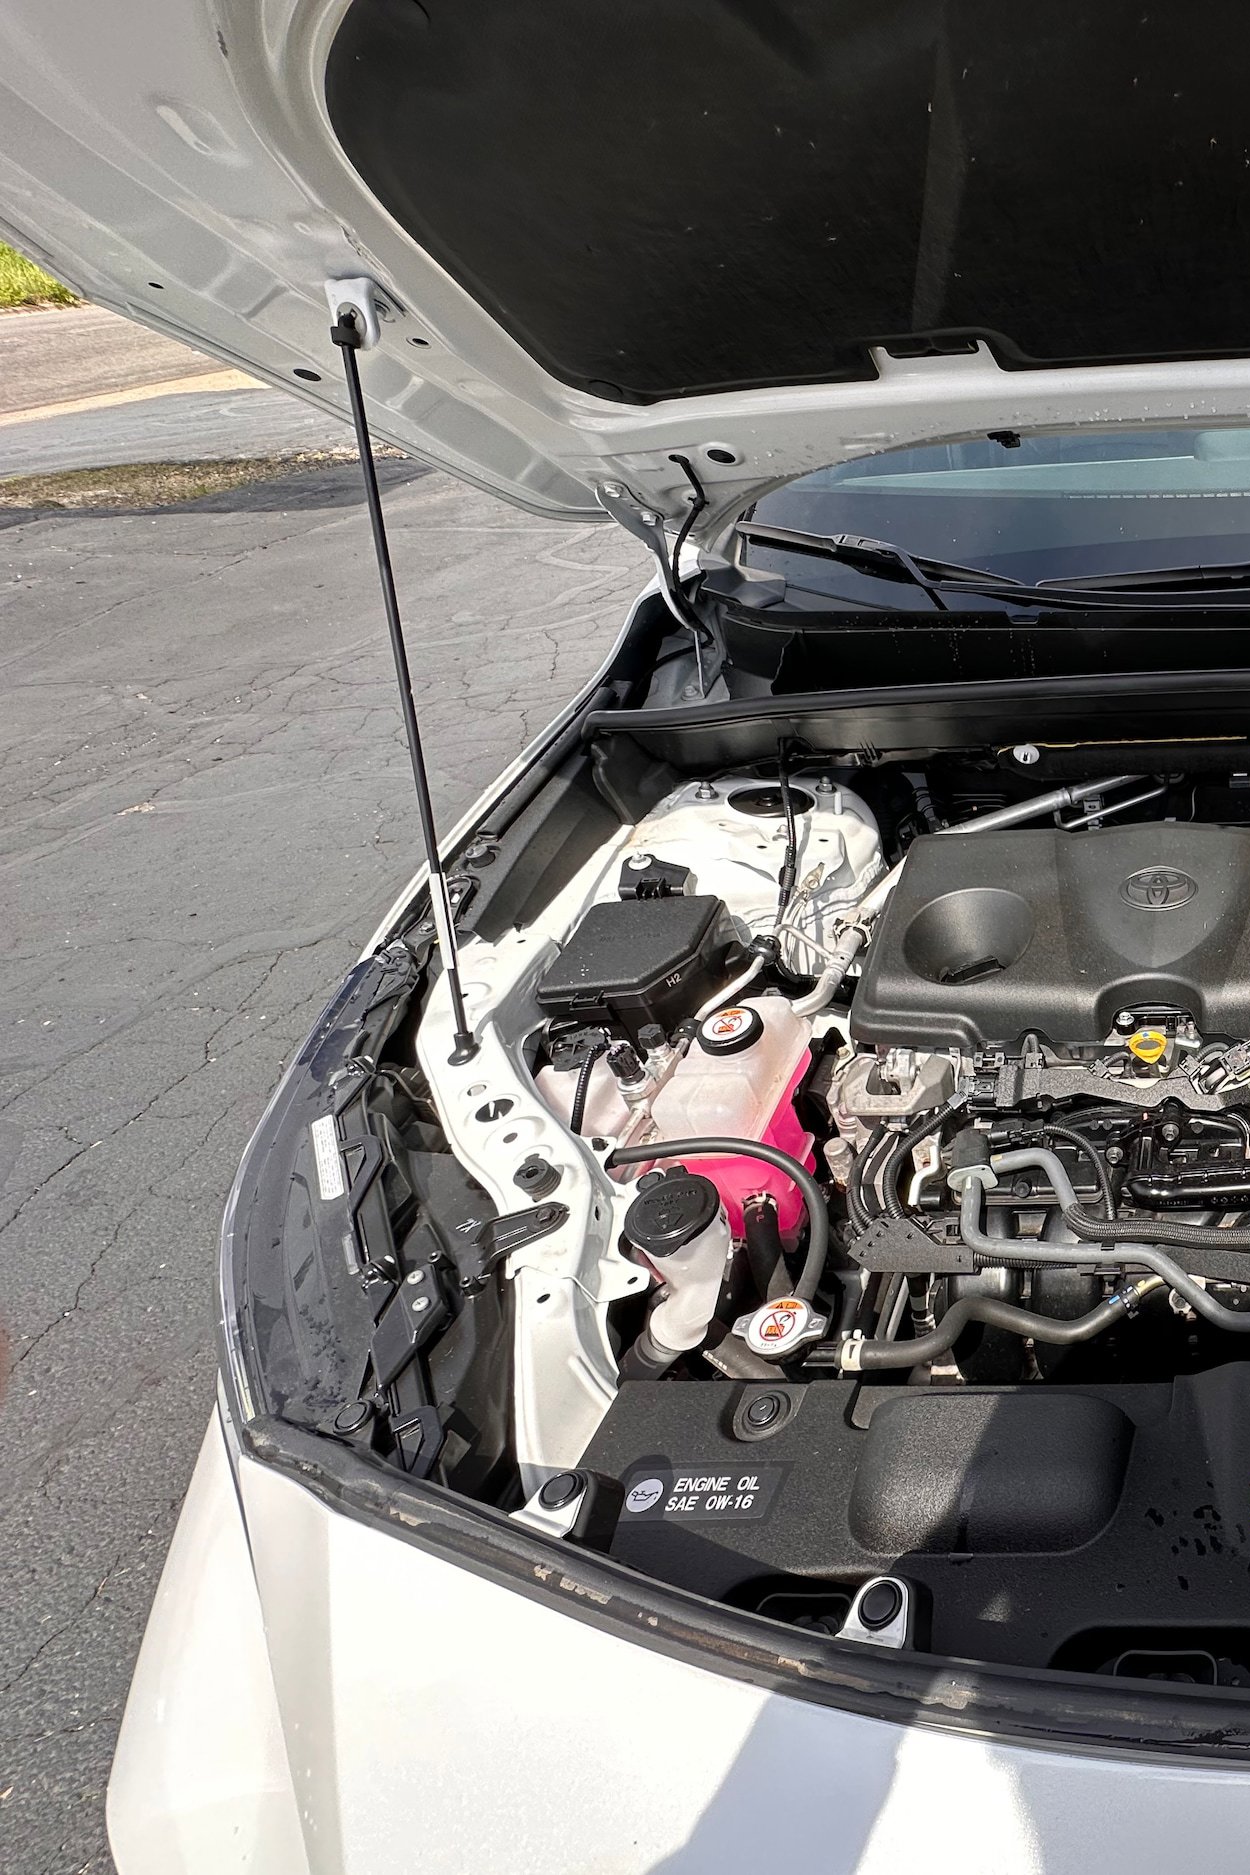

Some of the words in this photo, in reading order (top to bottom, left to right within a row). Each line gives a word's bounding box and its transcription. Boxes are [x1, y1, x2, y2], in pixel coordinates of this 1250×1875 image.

[665, 973, 682, 987] H2
[673, 1477, 731, 1492] ENGINE
[737, 1476, 760, 1491] OIL
[665, 1496, 699, 1511] SAE
[705, 1495, 754, 1510] 0W-16
